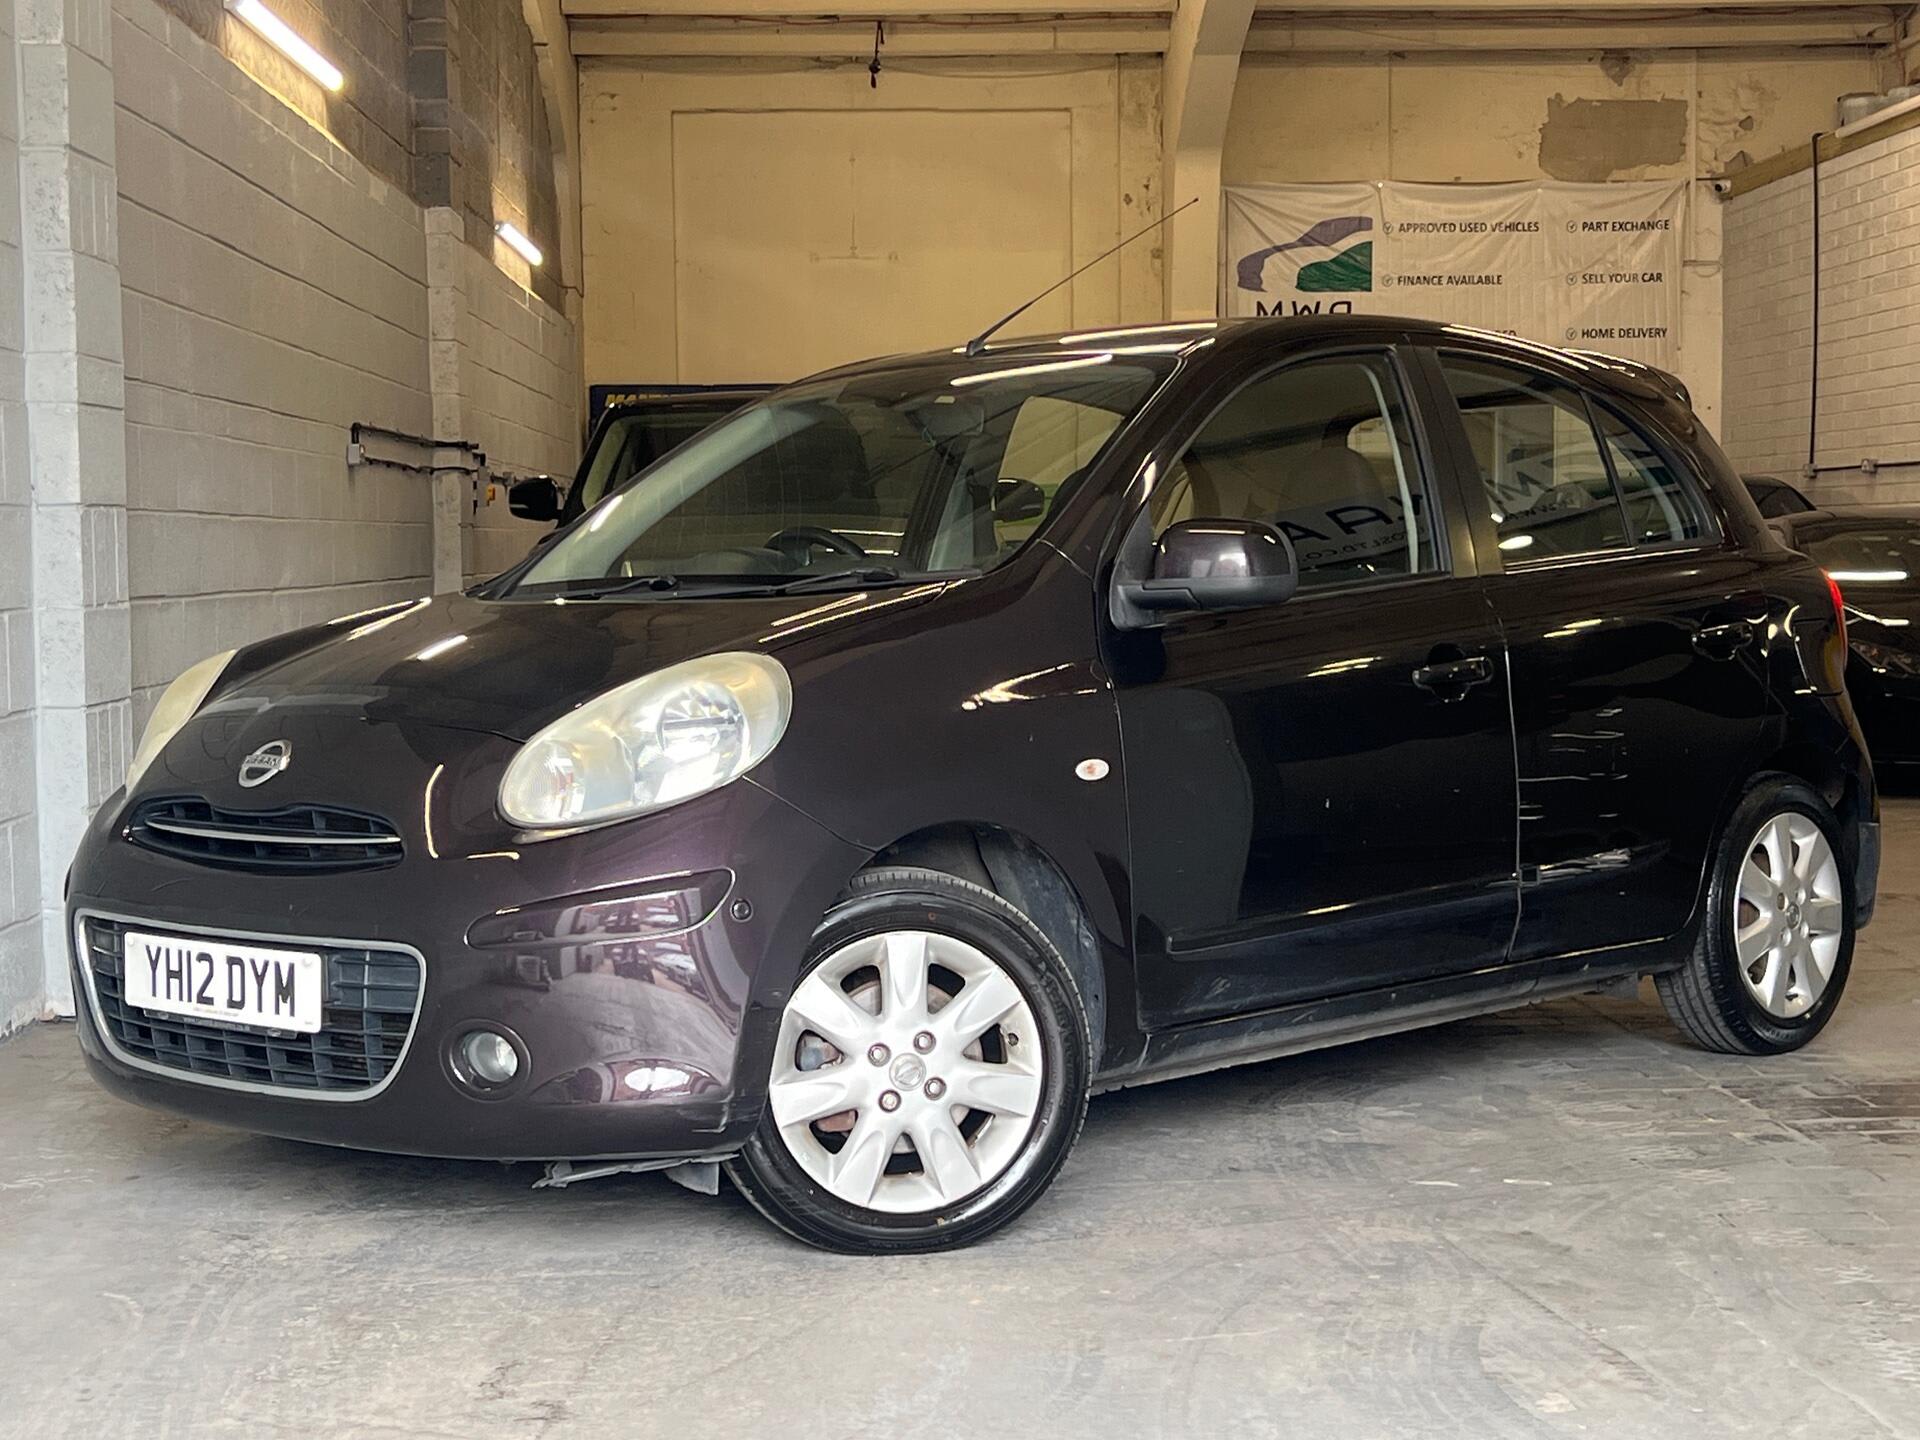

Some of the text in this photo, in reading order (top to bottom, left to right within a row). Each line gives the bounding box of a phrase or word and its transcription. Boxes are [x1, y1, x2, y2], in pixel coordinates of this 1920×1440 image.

[1398, 221, 1540, 233] APPROVED USED VEHICLES
[1581, 219, 1670, 232] PART EXCHANGE
[1397, 274, 1503, 286] FINANCE AVAILABLE
[1581, 272, 1663, 284] SELL YOUR CAR
[1581, 327, 1668, 339] HOME DELIVERY
[145, 944, 295, 1018] YH12 DYM
